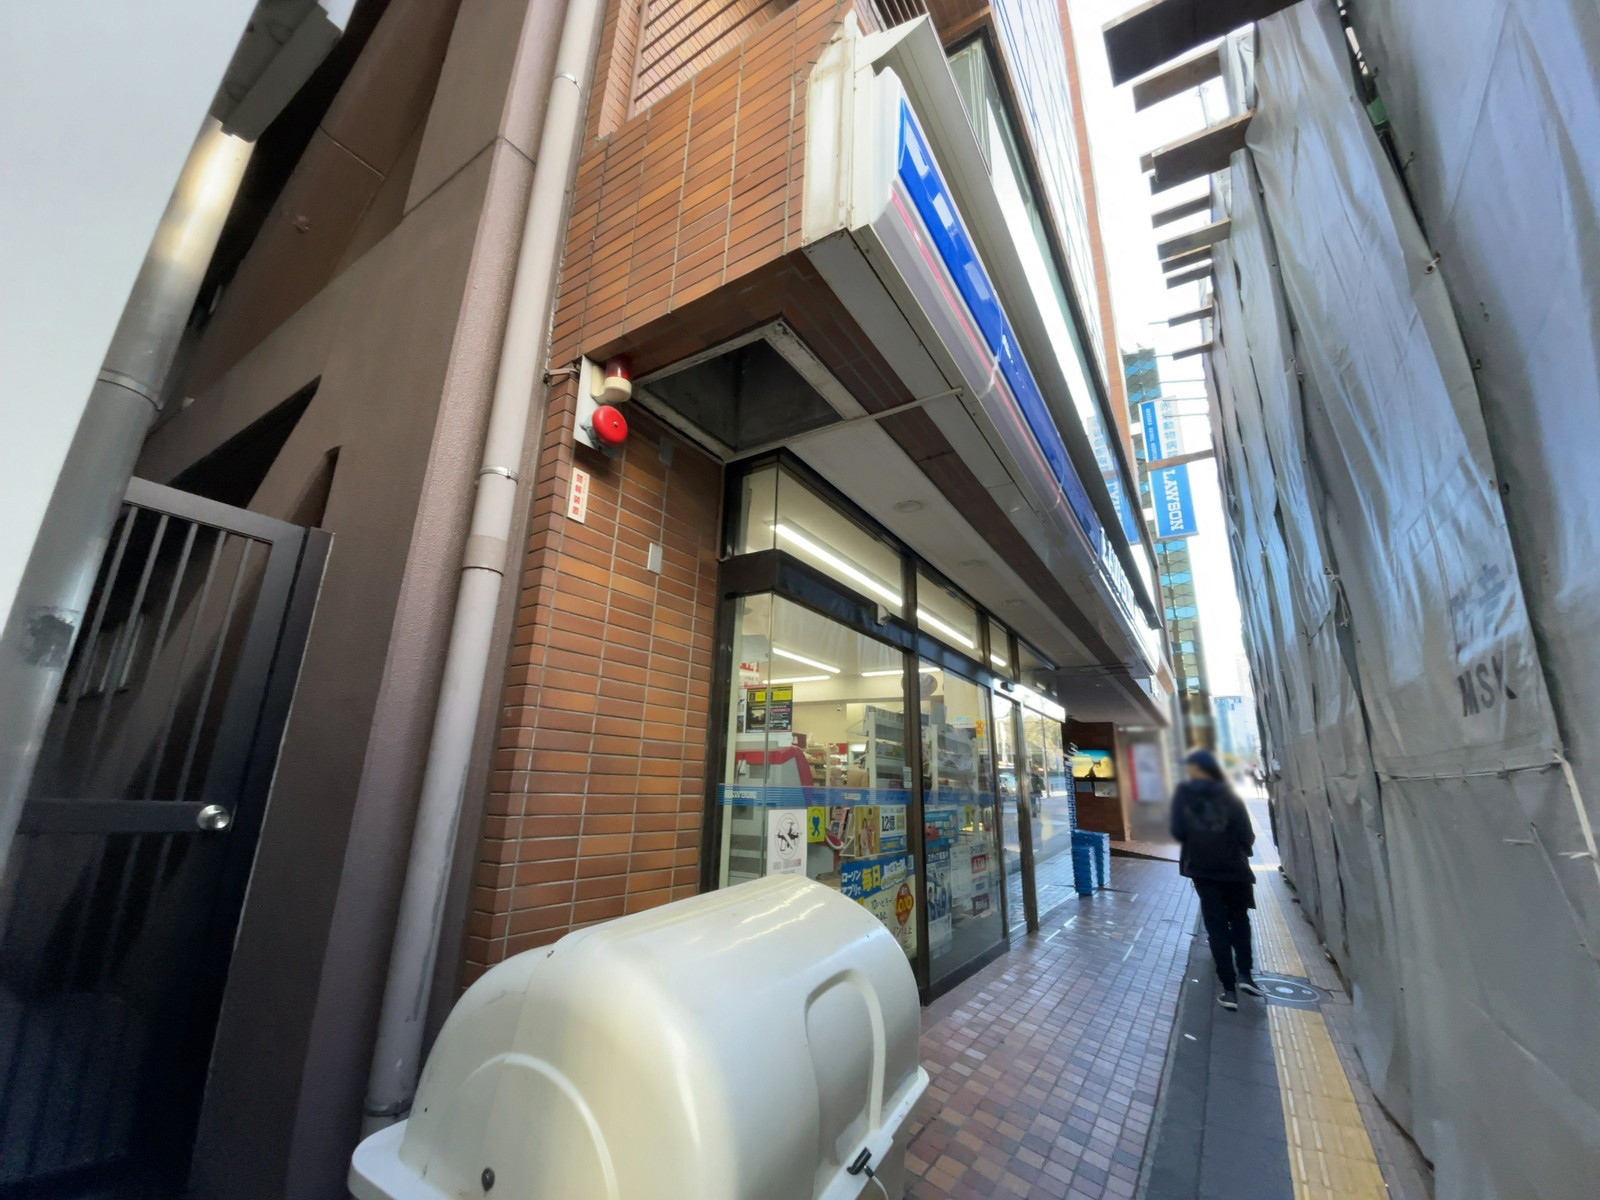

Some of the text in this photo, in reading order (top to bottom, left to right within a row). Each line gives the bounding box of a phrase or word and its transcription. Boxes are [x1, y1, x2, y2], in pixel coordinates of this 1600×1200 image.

[1162, 469, 1185, 532] LAWSON
[841, 869, 862, 883] ローソン
[861, 864, 881, 892] 毎日
